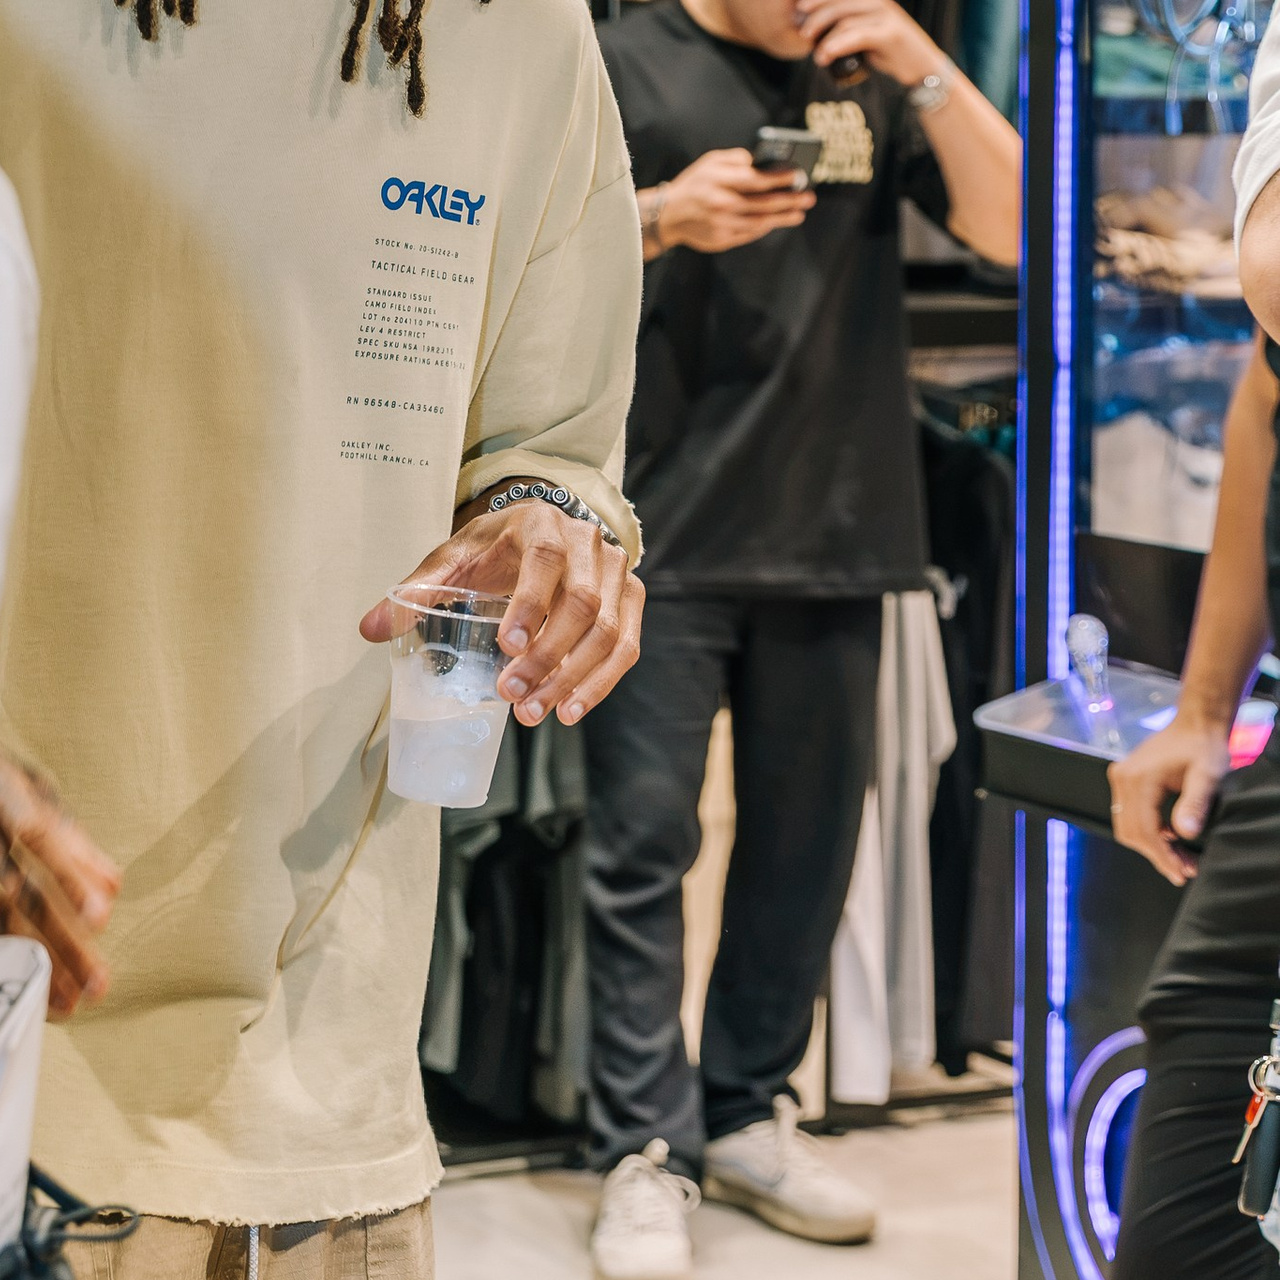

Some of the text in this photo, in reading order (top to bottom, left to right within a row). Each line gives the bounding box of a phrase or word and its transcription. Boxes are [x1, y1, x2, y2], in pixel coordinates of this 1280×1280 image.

[380, 176, 486, 226] OAKLEY
[374, 237, 401, 248] STOCK
[371, 259, 475, 285] TACTICAL FIELD GEAR
[366, 287, 432, 303] STANDARD ISSUE
[364, 299, 387, 310] CAMO
[389, 302, 412, 313] FIELD
[387, 327, 426, 339] RESTRICT
[357, 336, 380, 347] SPEC
[354, 349, 400, 362] EXPOSURE
[402, 354, 431, 366] RATING
[340, 440, 372, 450] OAKLEY
[339, 450, 378, 461] FOOTHILL
